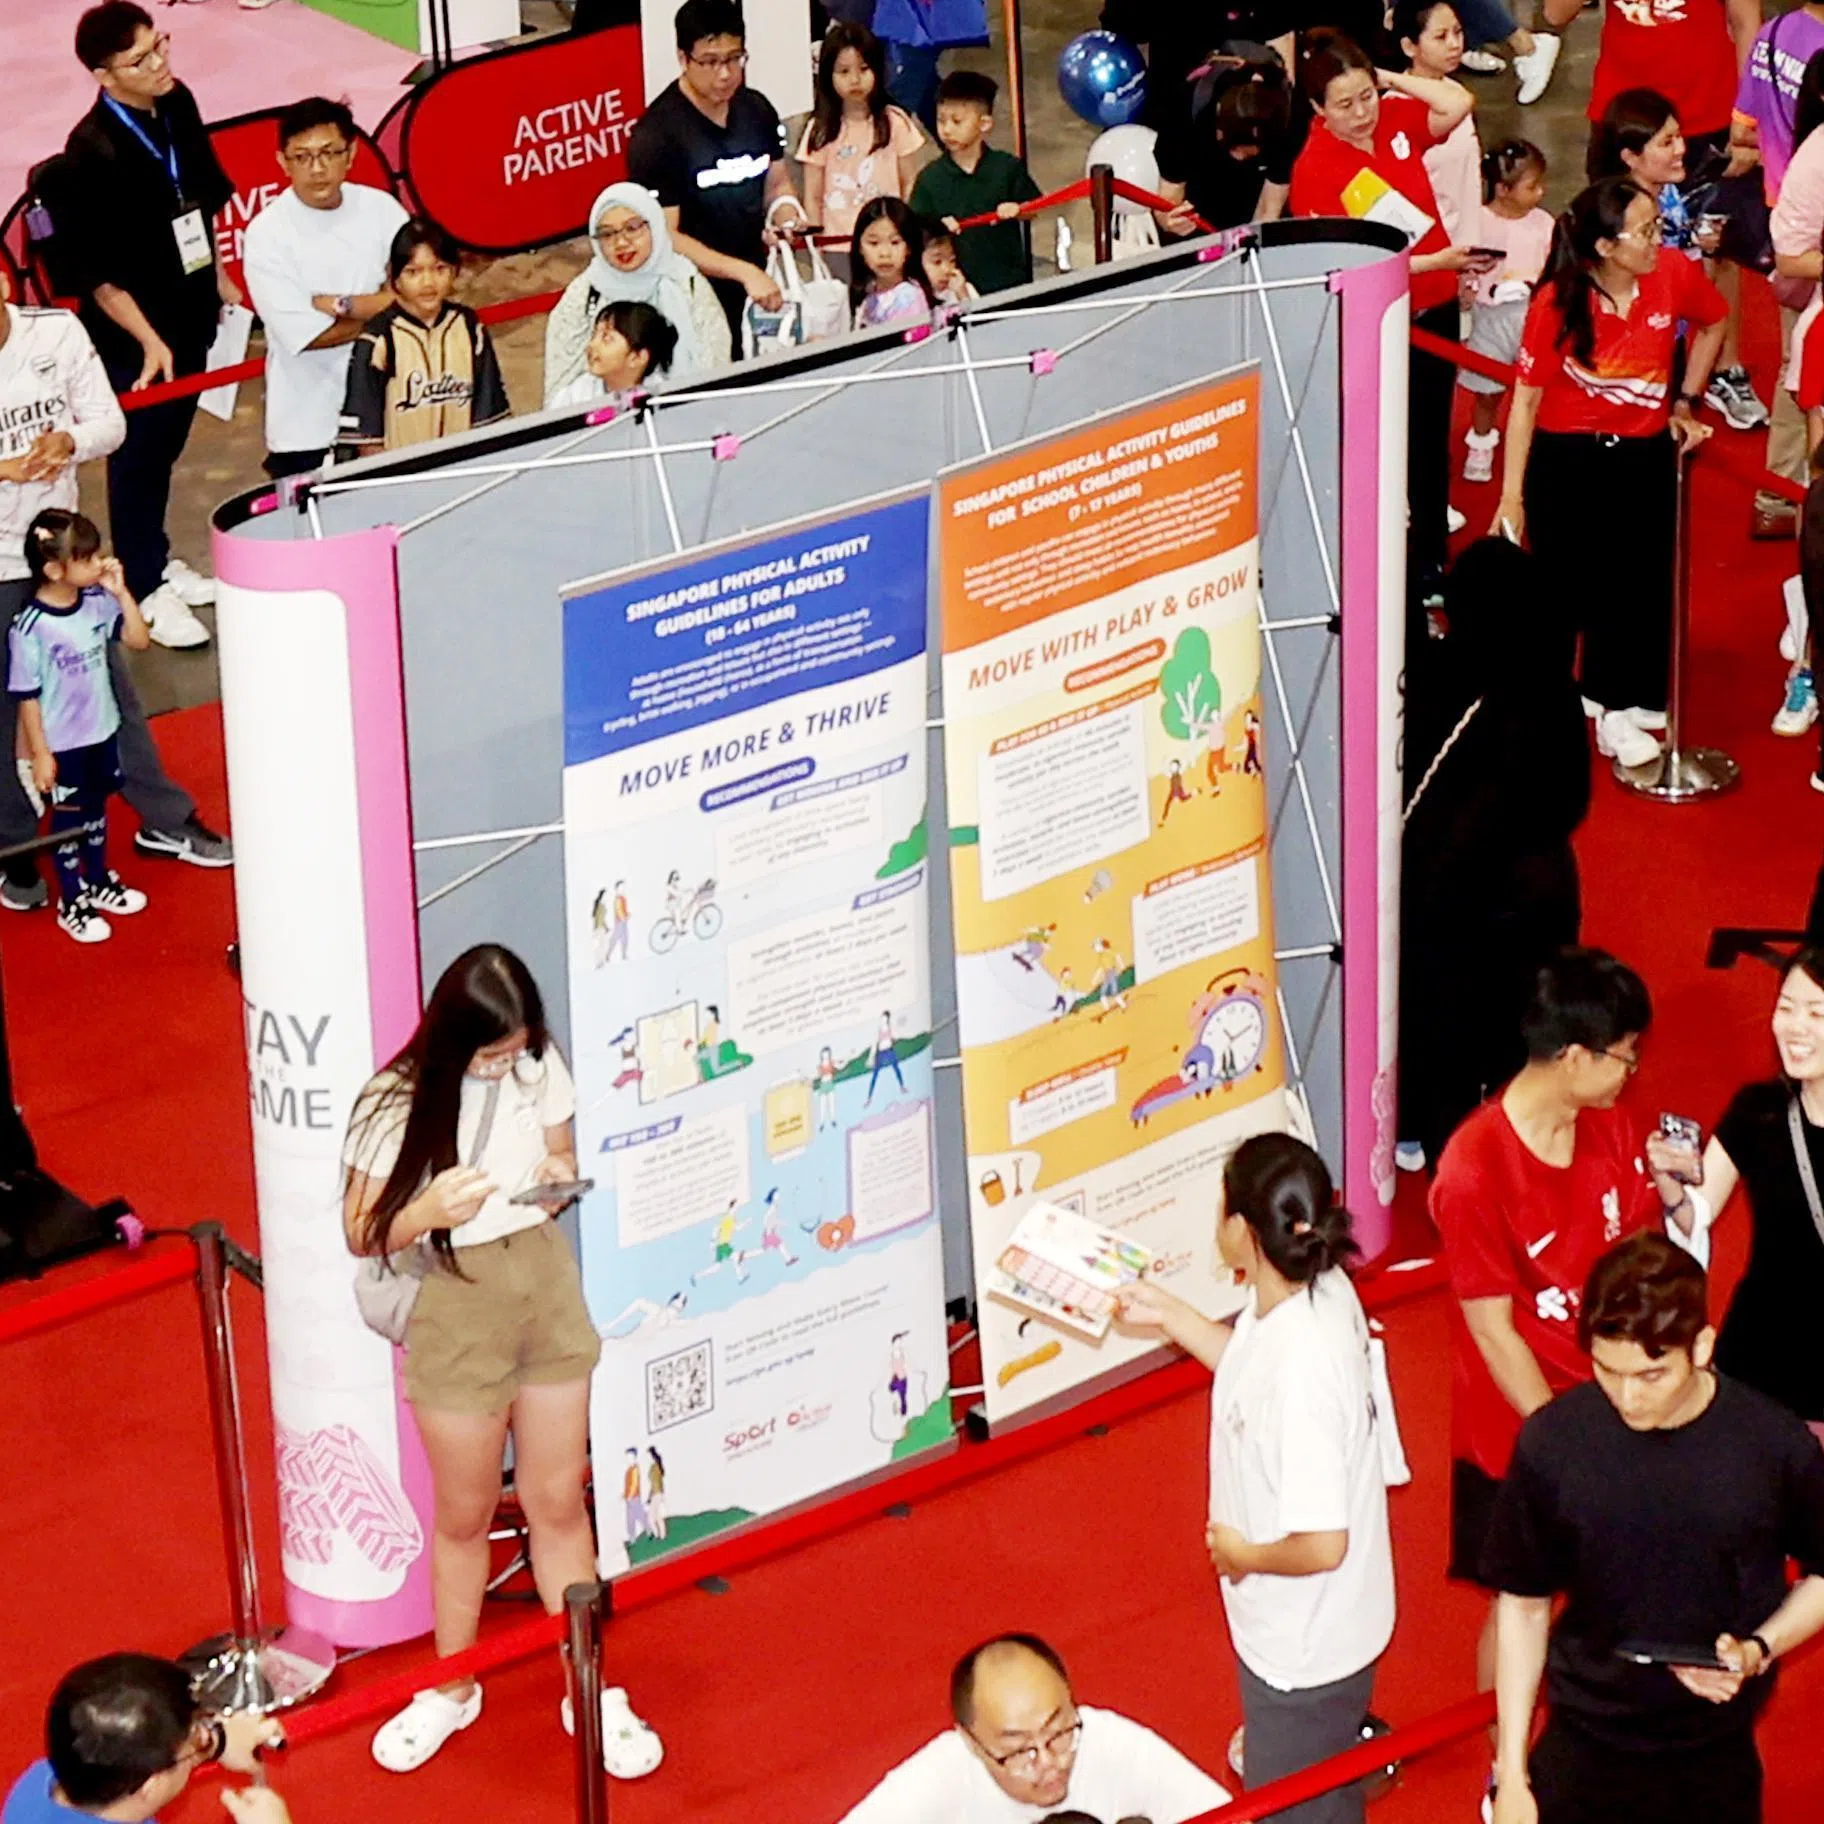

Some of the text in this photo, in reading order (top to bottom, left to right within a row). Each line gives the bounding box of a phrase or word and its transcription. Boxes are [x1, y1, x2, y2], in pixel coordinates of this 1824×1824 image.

[513, 88, 624, 150] ACTIVE
[953, 398, 1247, 518] SINGAPORE PHYSICAL ACTIVITY GUIDELINES
[987, 432, 1219, 530] FOR SCHOOL CHILDREN & YOUTHS
[1104, 482, 1143, 507] YEARS)
[626, 535, 871, 623] SINGAPORE PHYSICAL ACTIVITY
[655, 567, 846, 637] GUIDELINES FOR ADULTS
[705, 626, 726, 646] (18
[734, 618, 751, 635] 64
[751, 604, 797, 630] YEARS)
[968, 566, 1248, 691] MOVE WITH PLAY & GROW
[620, 690, 892, 797] MOVE MORE & THRIVE
[243, 994, 331, 1067] TAY
